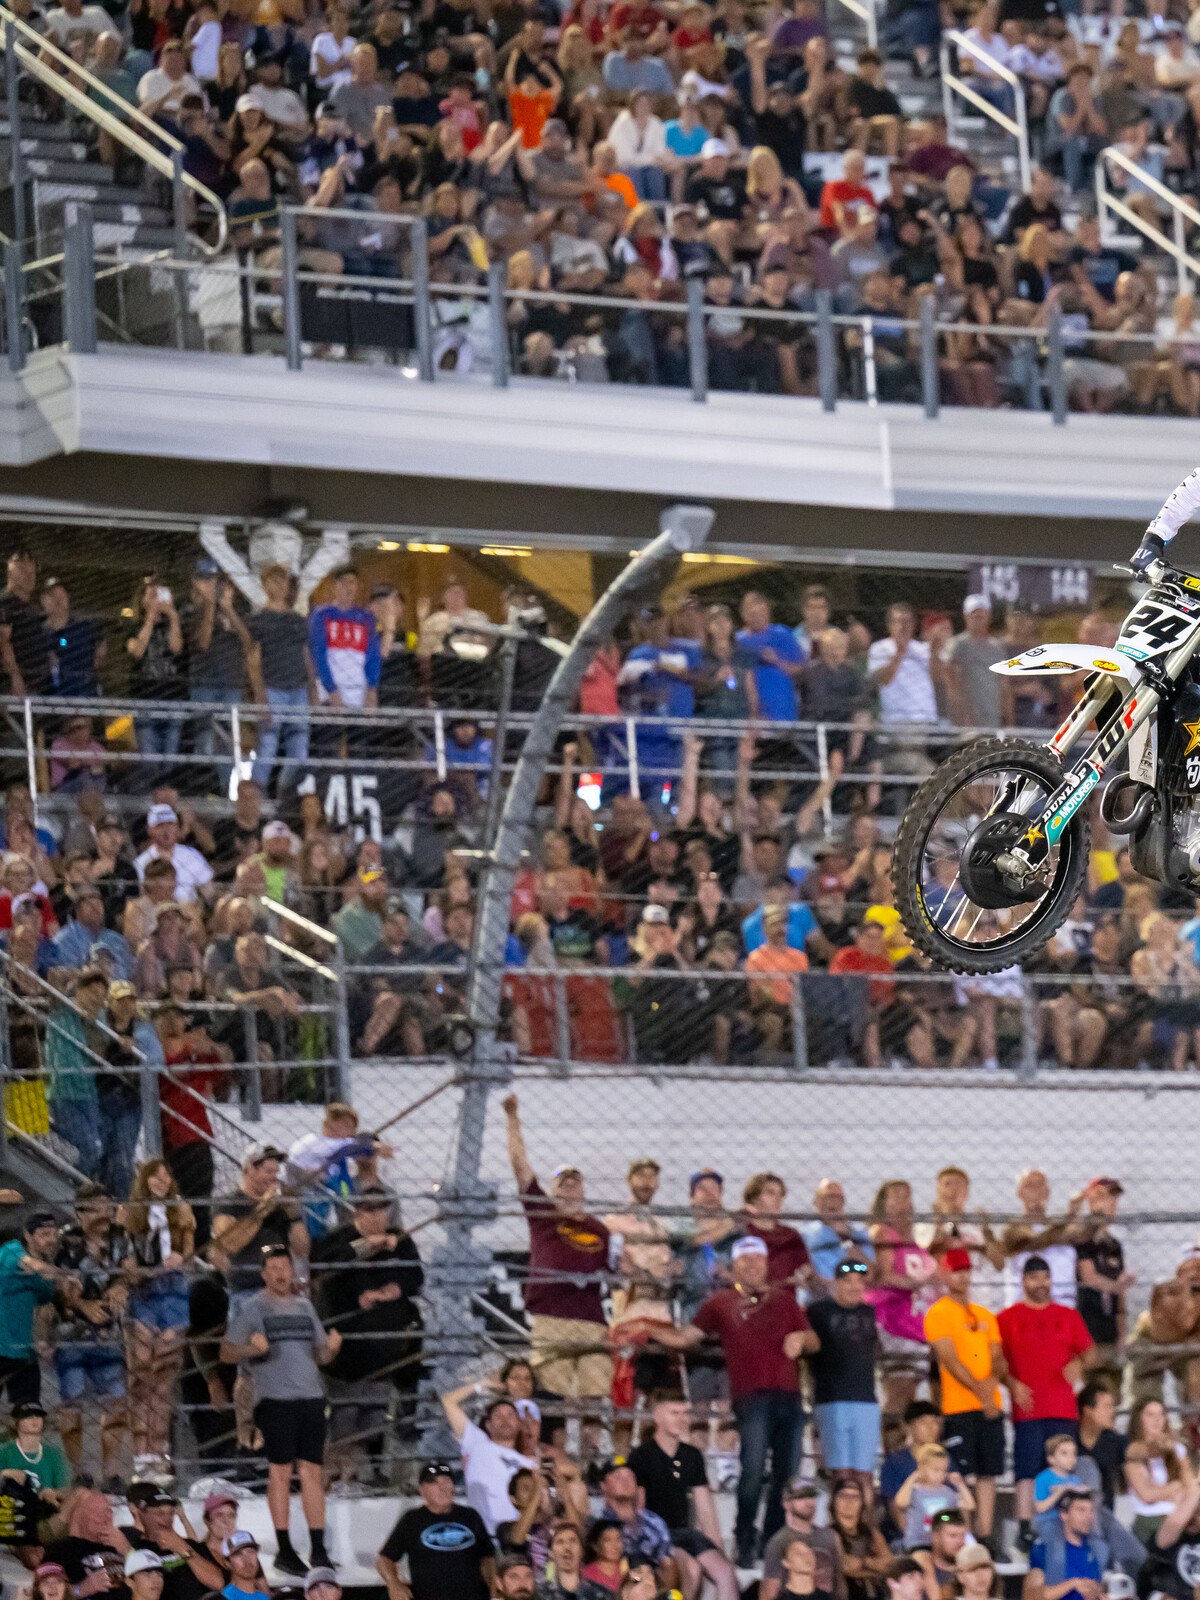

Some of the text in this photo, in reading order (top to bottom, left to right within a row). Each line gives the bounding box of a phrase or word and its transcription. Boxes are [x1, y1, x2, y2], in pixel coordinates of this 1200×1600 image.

[1120, 605, 1193, 650] 24
[1097, 698, 1138, 763] WP
[1042, 766, 1088, 823] DUNLP
[1060, 774, 1098, 819] MOTOREX
